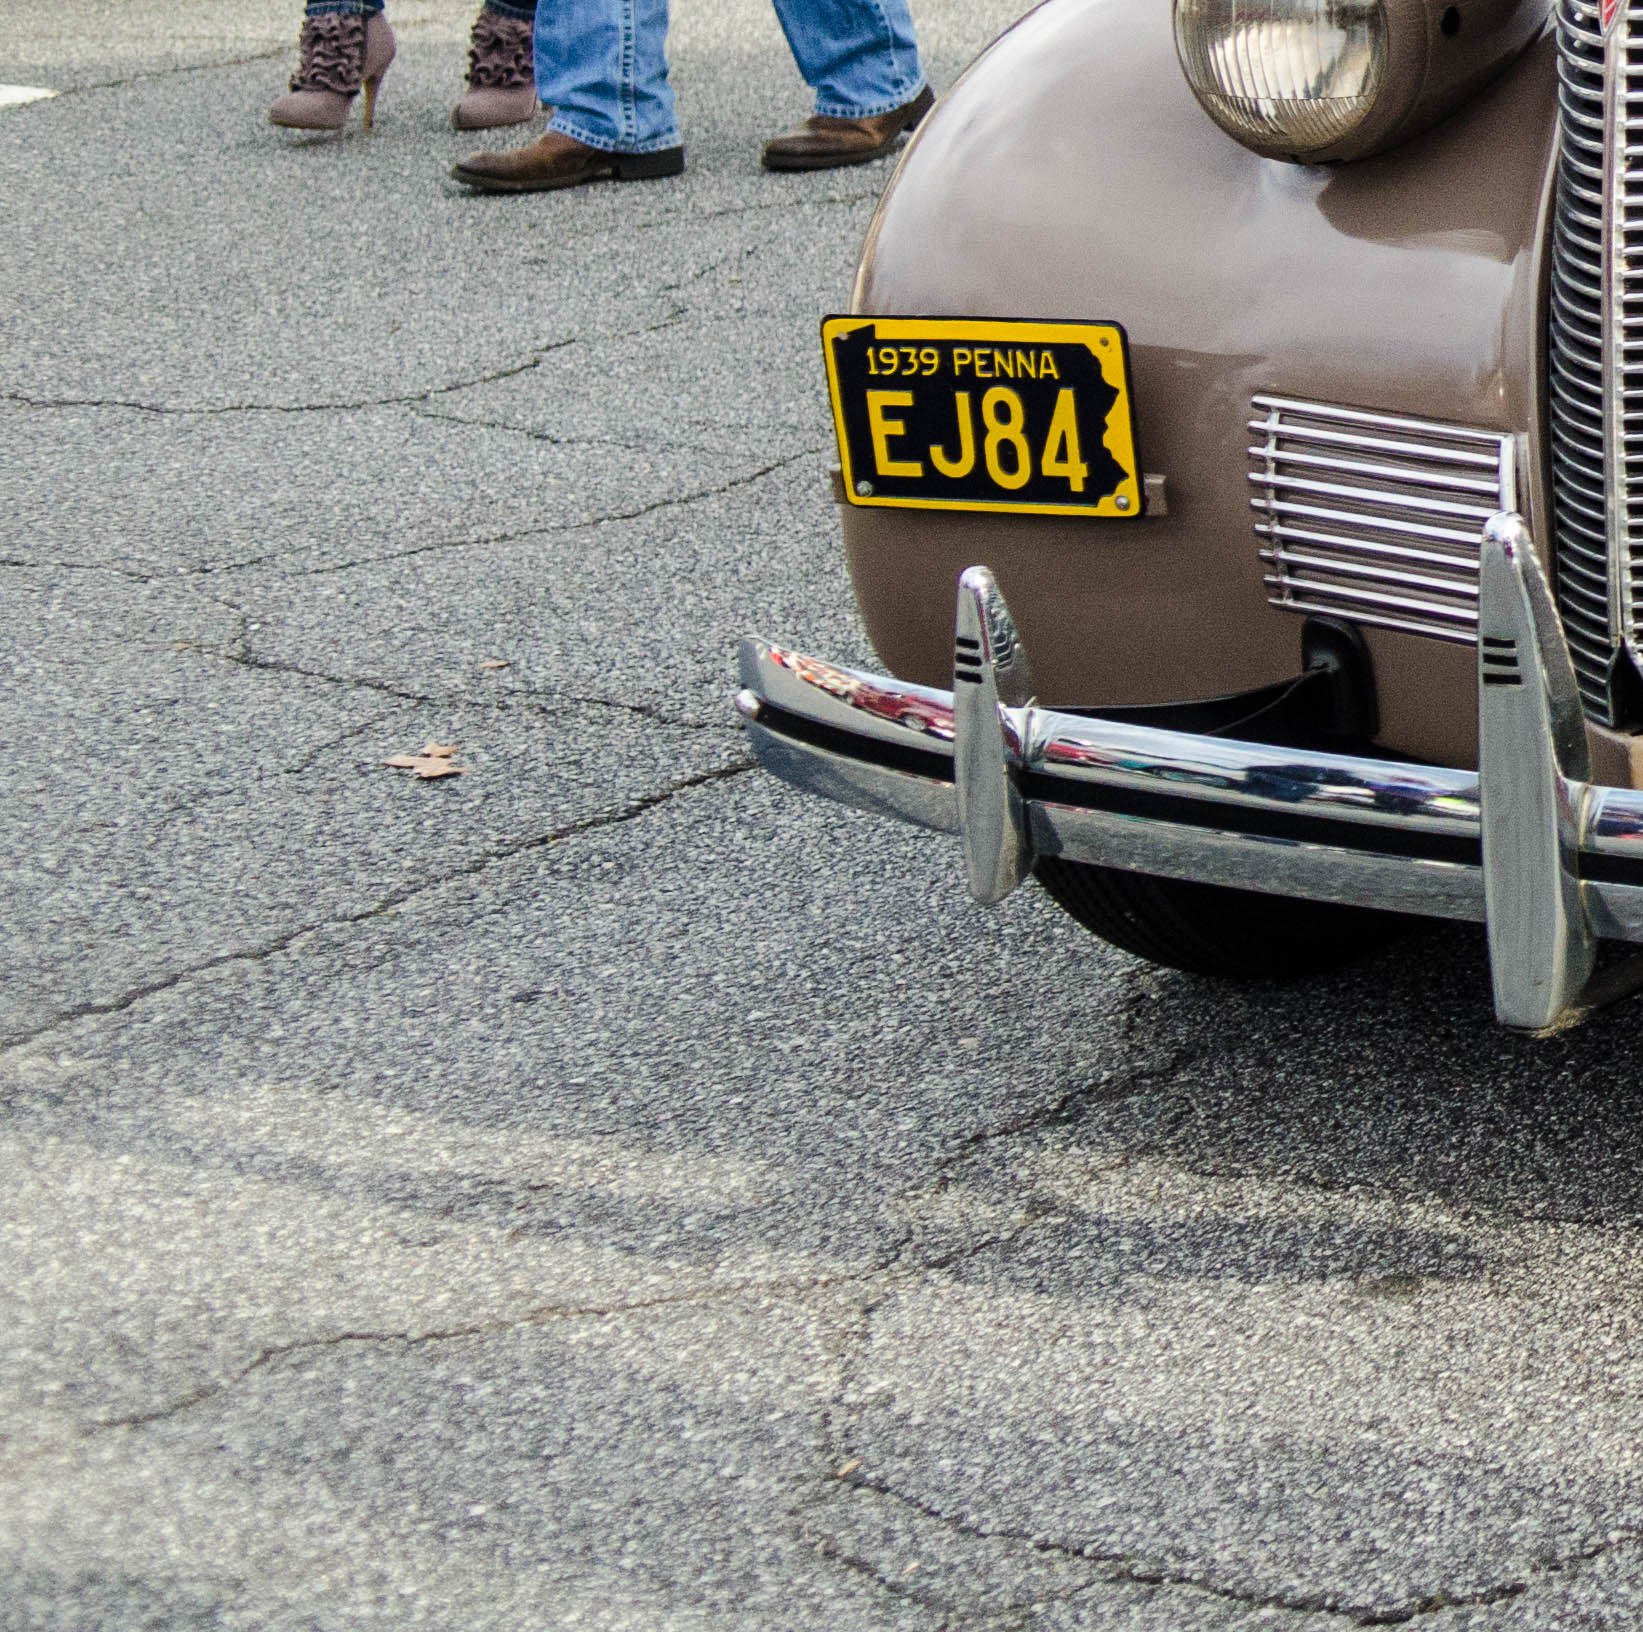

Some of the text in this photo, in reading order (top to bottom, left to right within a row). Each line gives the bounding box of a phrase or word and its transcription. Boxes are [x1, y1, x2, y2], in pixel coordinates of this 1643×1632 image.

[866, 346, 1060, 380] 1939 PENNA
[865, 385, 1089, 493] EJ84
